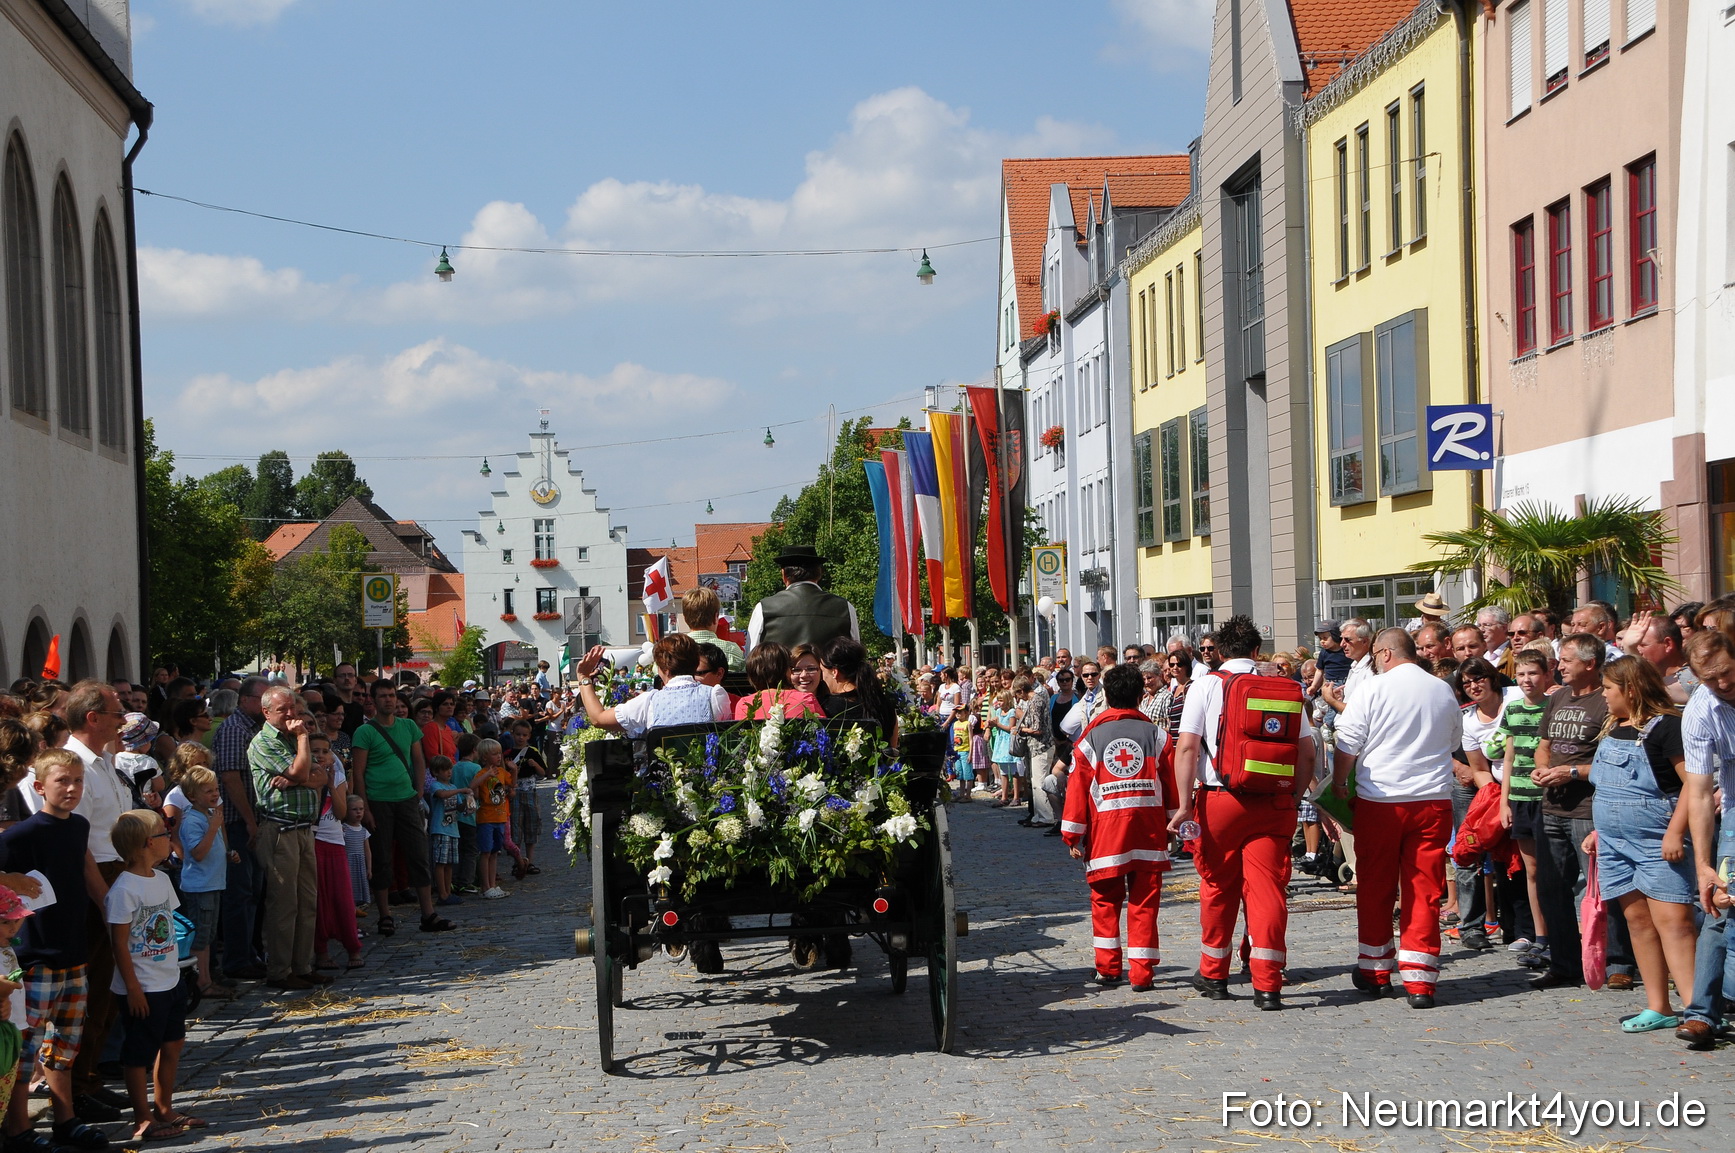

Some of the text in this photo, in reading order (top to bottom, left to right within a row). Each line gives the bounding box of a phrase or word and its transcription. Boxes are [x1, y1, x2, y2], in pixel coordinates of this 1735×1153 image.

[1555, 710, 1587, 722] GOLDEN
[1108, 741, 1139, 755] DEUTSCHES
[1107, 756, 1141, 774] ROTES KREUZ
